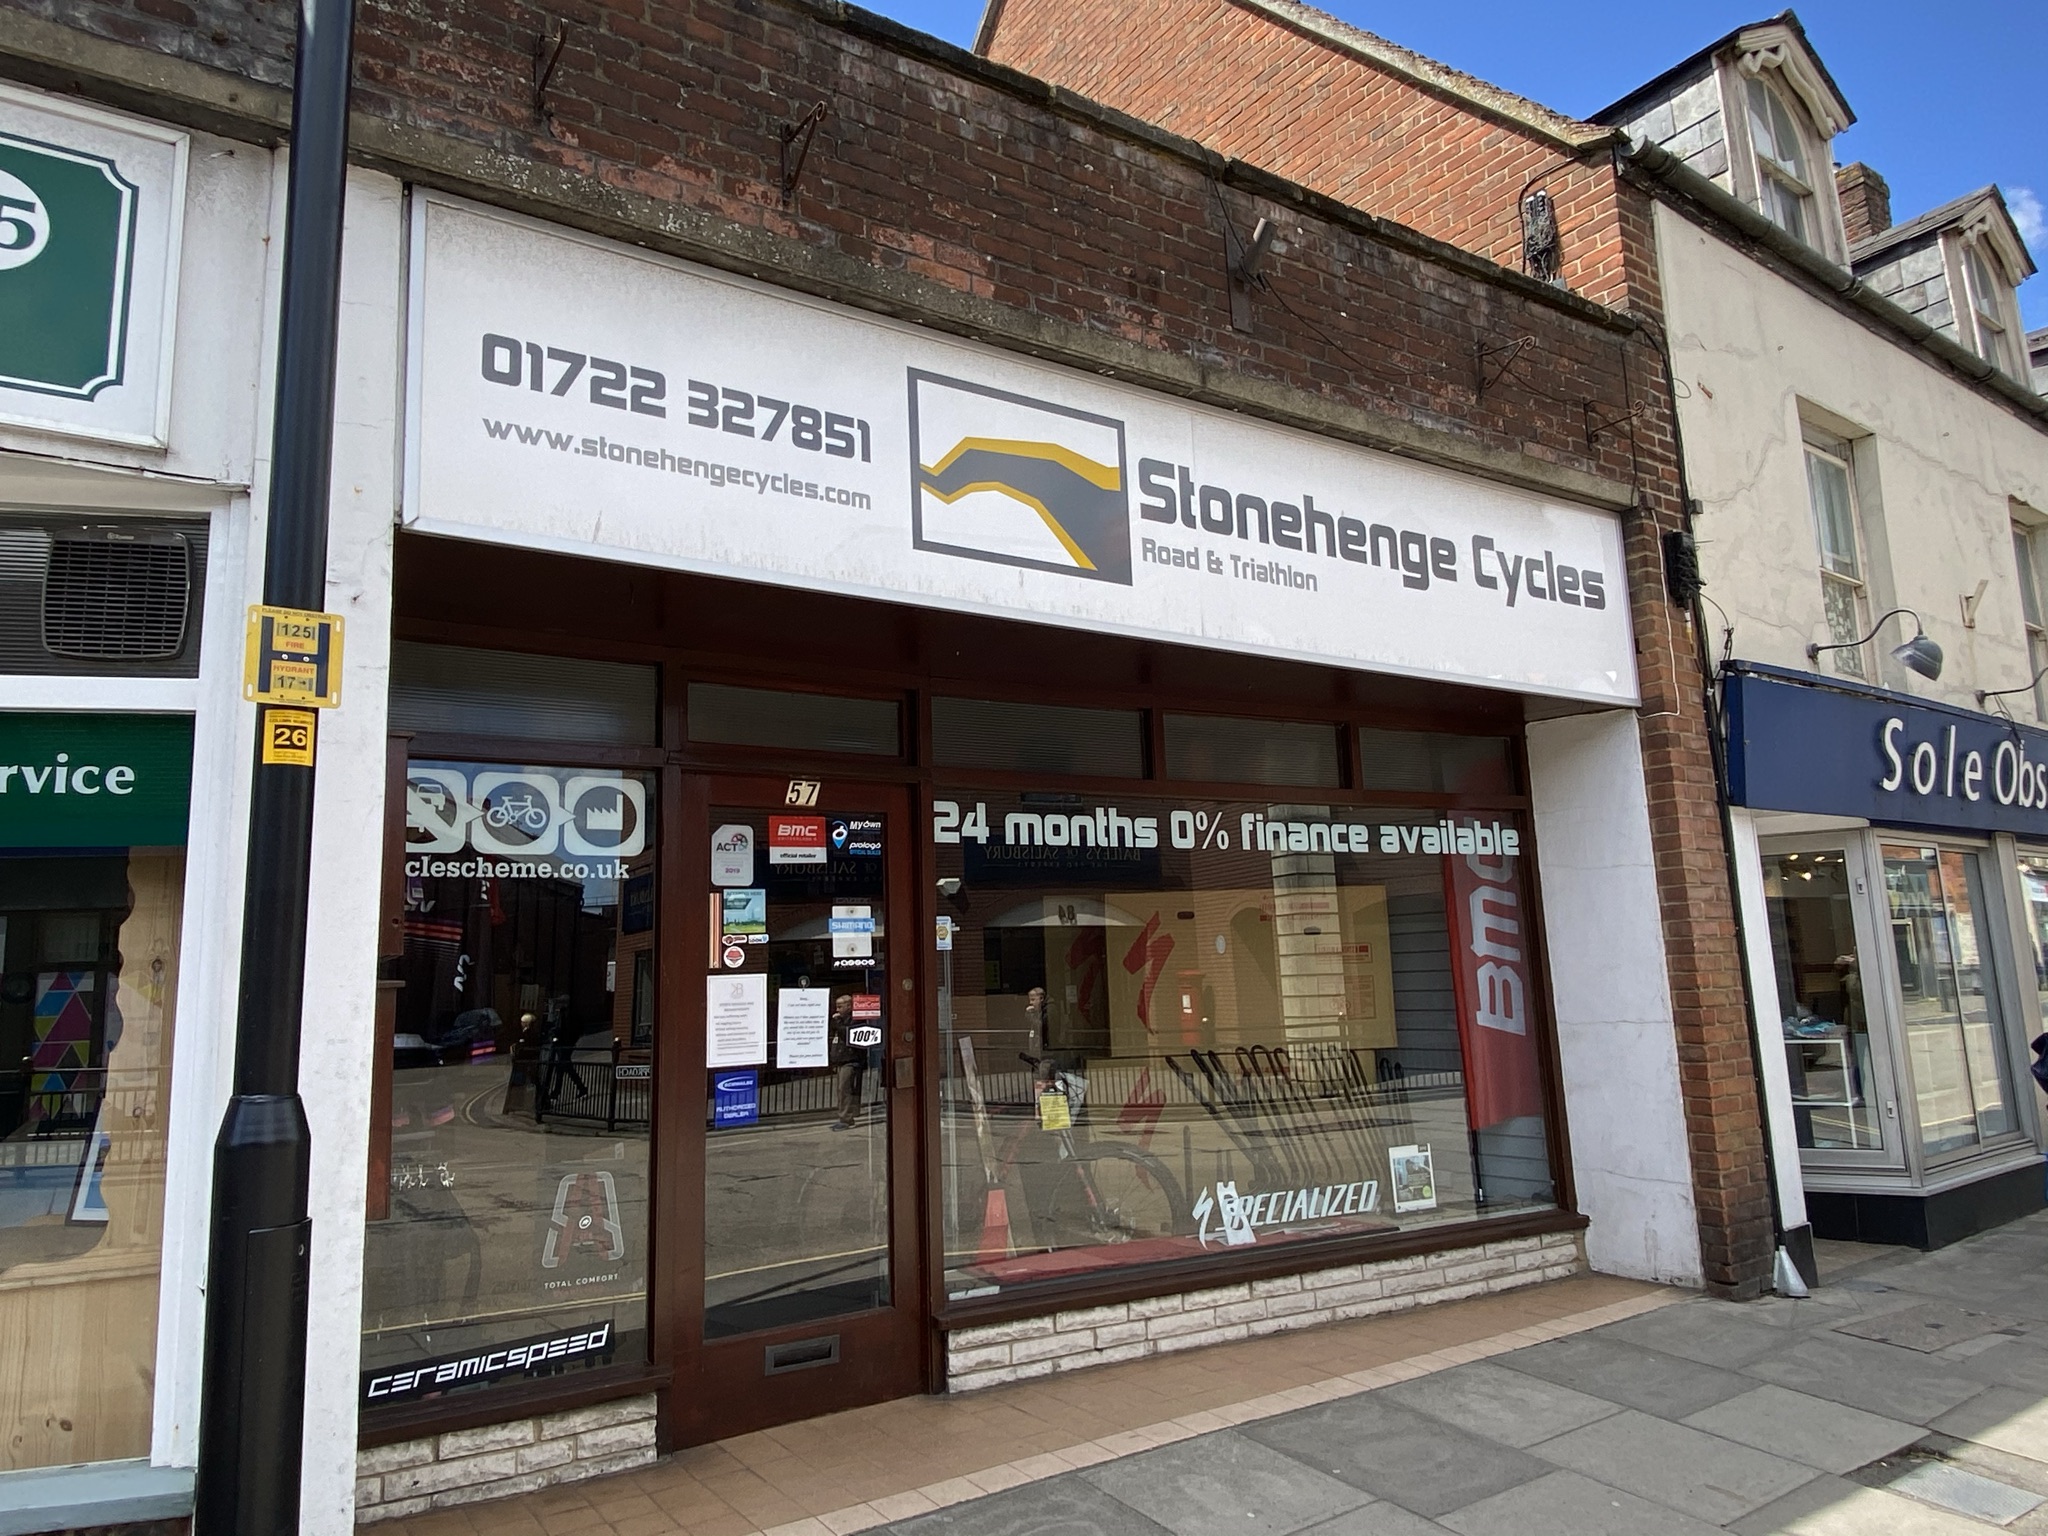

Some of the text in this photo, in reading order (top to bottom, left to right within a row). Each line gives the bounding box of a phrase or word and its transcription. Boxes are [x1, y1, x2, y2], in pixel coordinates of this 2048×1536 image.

[481, 333, 872, 463] 01722 327851
[482, 418, 872, 510] www.stonehengecycles.com
[1138, 457, 1606, 611] Stonehenge Cycles
[1141, 537, 1318, 592] Road & Triathlon
[283, 623, 311, 639] 125
[285, 641, 304, 650] FIRE
[273, 664, 315, 675] HYDRANT
[274, 727, 307, 747] 26
[1882, 717, 1983, 802] Sole
[788, 781, 818, 805] 57
[933, 800, 1520, 856] 24 months 0% finance available
[716, 842, 738, 852] ACT
[405, 855, 630, 880] clescheme.co.uk
[831, 921, 874, 930] SHIMANO
[853, 1029, 879, 1043] 100%
[544, 1272, 619, 1290] TOTAL COMFORT
